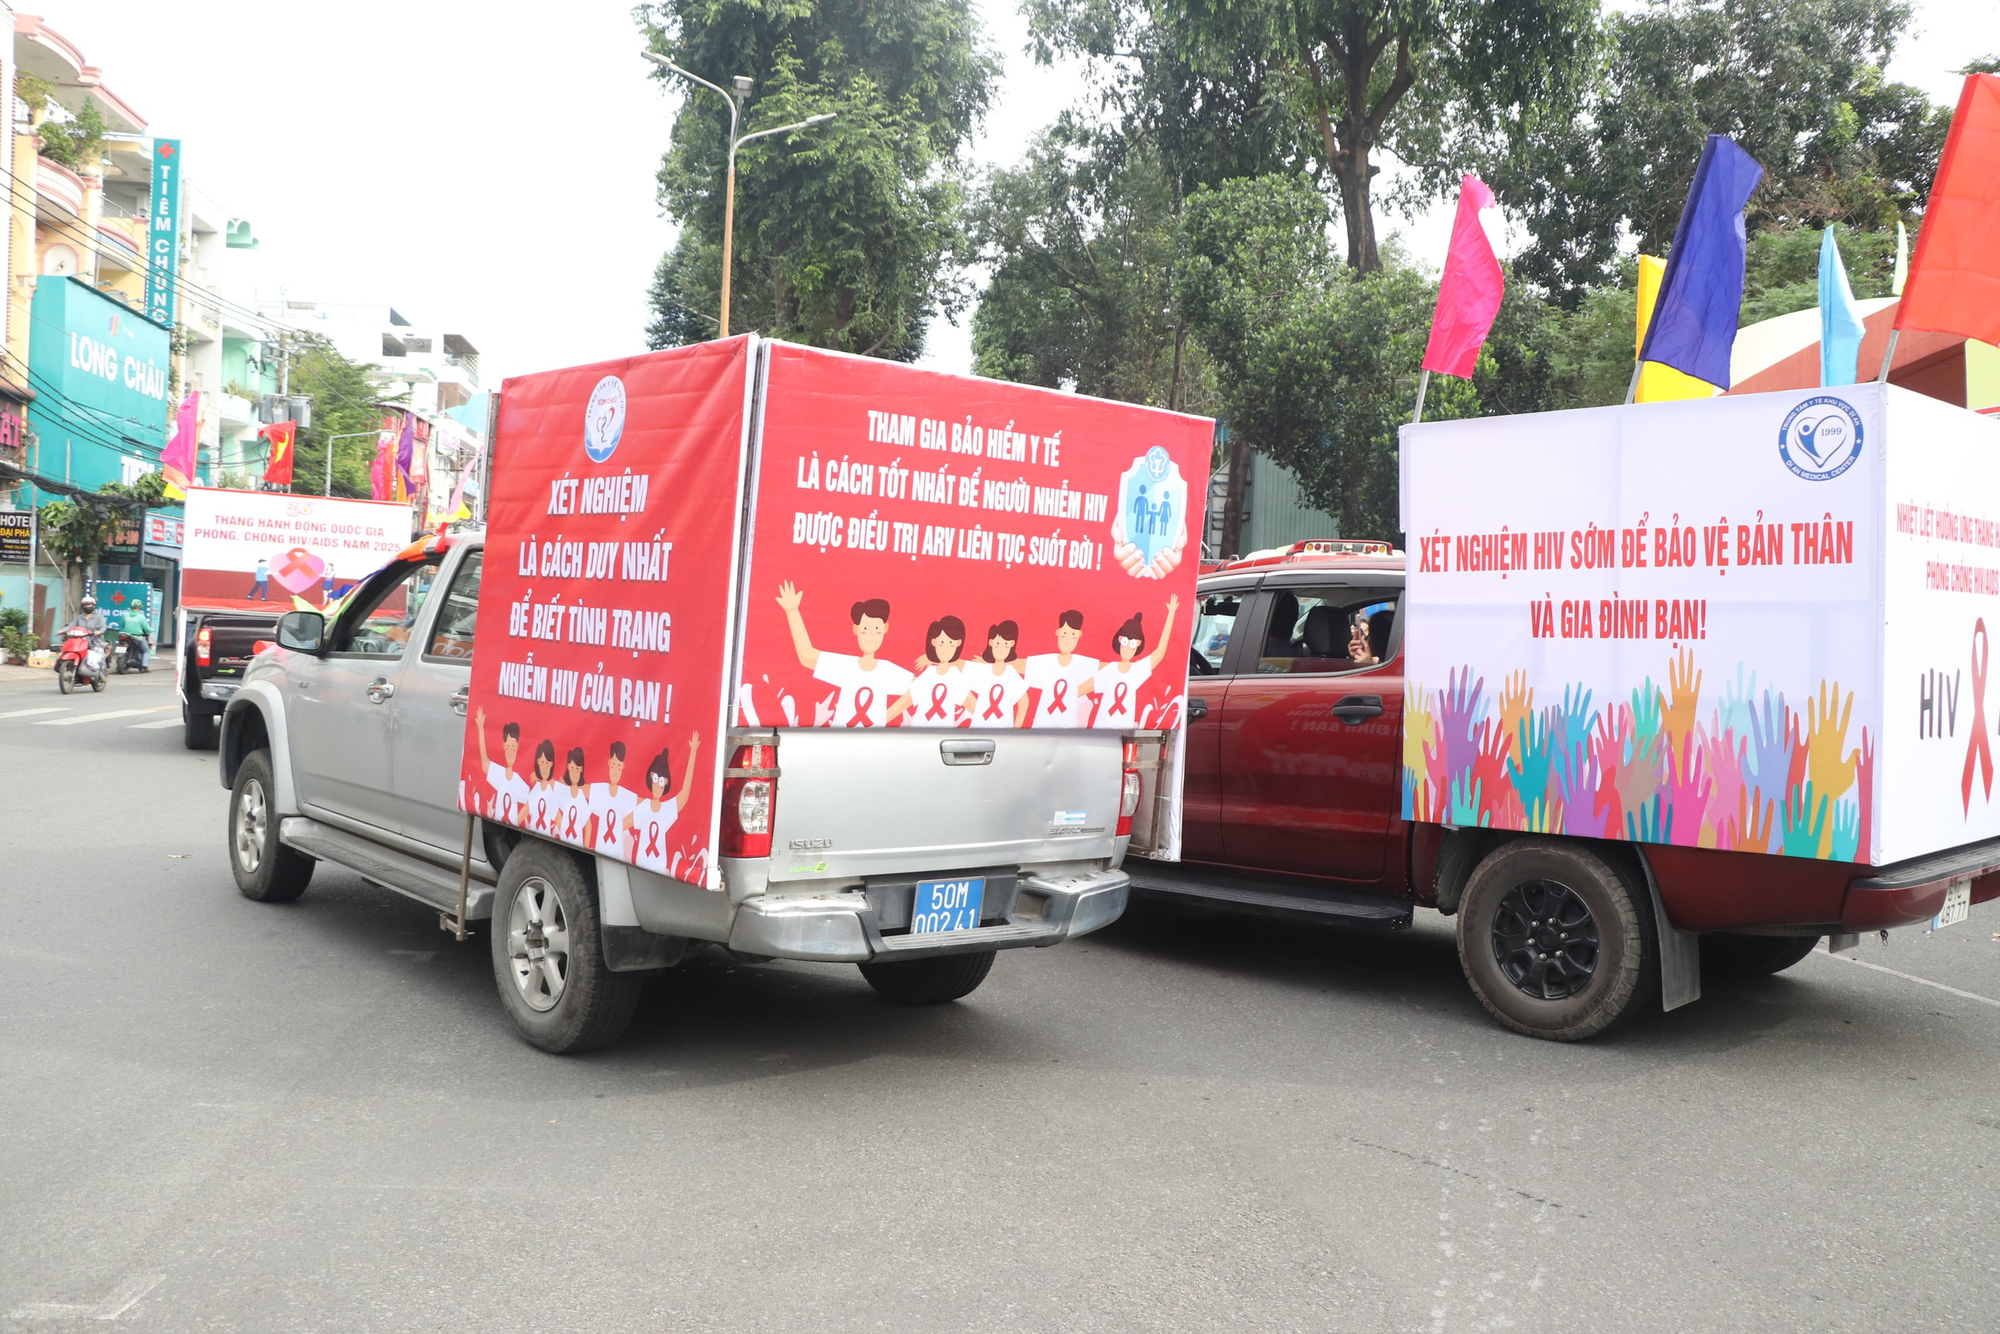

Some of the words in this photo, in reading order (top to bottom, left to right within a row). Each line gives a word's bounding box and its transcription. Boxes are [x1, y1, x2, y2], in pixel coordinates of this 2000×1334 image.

[155, 165, 171, 231] TIÊM
[71, 331, 118, 382] LONG
[123, 355, 165, 401] CHÂU
[867, 410, 915, 447] THAM
[919, 418, 948, 451] GIA
[951, 415, 984, 456] BẢO
[987, 419, 1026, 462] HIỂM
[1029, 437, 1041, 464] Y
[1043, 430, 1062, 467] TẾ
[1782, 412, 1797, 431] TRUNG
[1796, 402, 1809, 412] TÂM
[1838, 402, 1851, 412] VỰC
[1853, 417, 1861, 426] AN
[1820, 427, 1842, 436] 1999
[547, 472, 579, 515] XÉT
[580, 467, 649, 522] NGHIỆM
[797, 451, 821, 489] LÀ
[825, 454, 873, 496] CÁCH
[878, 456, 909, 500] TỐT
[911, 463, 956, 506] NHẤT
[958, 466, 981, 508] ĐỂ
[983, 476, 1030, 514] NGƯỜI
[1033, 478, 1082, 520] NHIỄM
[1084, 493, 1109, 523] HIV
[1792, 465, 1801, 475] AN
[1800, 471, 1830, 480] MEDICAL
[1831, 455, 1856, 477] CENTER
[289, 535, 339, 548] HIV/AIDS
[373, 541, 401, 552] 2025
[365, 526, 384, 536] GIA
[519, 534, 537, 576] LÀ
[541, 534, 583, 578] CÁCH
[585, 541, 619, 580] DUY
[622, 528, 673, 582] NHẤT
[792, 511, 843, 554] ĐƯỢC
[847, 509, 889, 551] ĐIỀU
[893, 521, 919, 561] TRỊ
[921, 524, 955, 557] ARV
[957, 526, 993, 561] LIÊN
[997, 532, 1027, 569] TỤC
[1029, 529, 1068, 567] SUỐT
[1069, 536, 1094, 570] ĐỜI
[1418, 530, 1451, 573] XÉT
[1456, 525, 1528, 579] NGHIỆM
[1533, 532, 1567, 571] HIV
[1570, 518, 1616, 570] SỚM
[1620, 510, 1651, 569] ĐỂ
[1654, 512, 1697, 568] BẢO
[1702, 519, 1730, 576] VỆ
[1736, 509, 1783, 566] BẢN
[1790, 512, 1854, 565] THÂN
[509, 588, 531, 638] ĐỂ
[531, 593, 565, 641] BIẾT
[568, 599, 607, 646] TÌNH
[611, 609, 672, 658] TRẠNG
[1530, 591, 1555, 640] VÀ
[1560, 600, 1594, 640] GIA
[1599, 591, 1648, 640] ĐÌNH
[1654, 599, 1707, 649] BẠN!
[498, 652, 548, 703] NHIỄM
[550, 668, 579, 707] HIV
[580, 662, 614, 713] CỦA
[619, 679, 661, 728] BẠN
[1920, 668, 1960, 740] HIV
[789, 837, 833, 850] ISUZU
[914, 908, 976, 934] 00241
[931, 881, 970, 910] 50M
